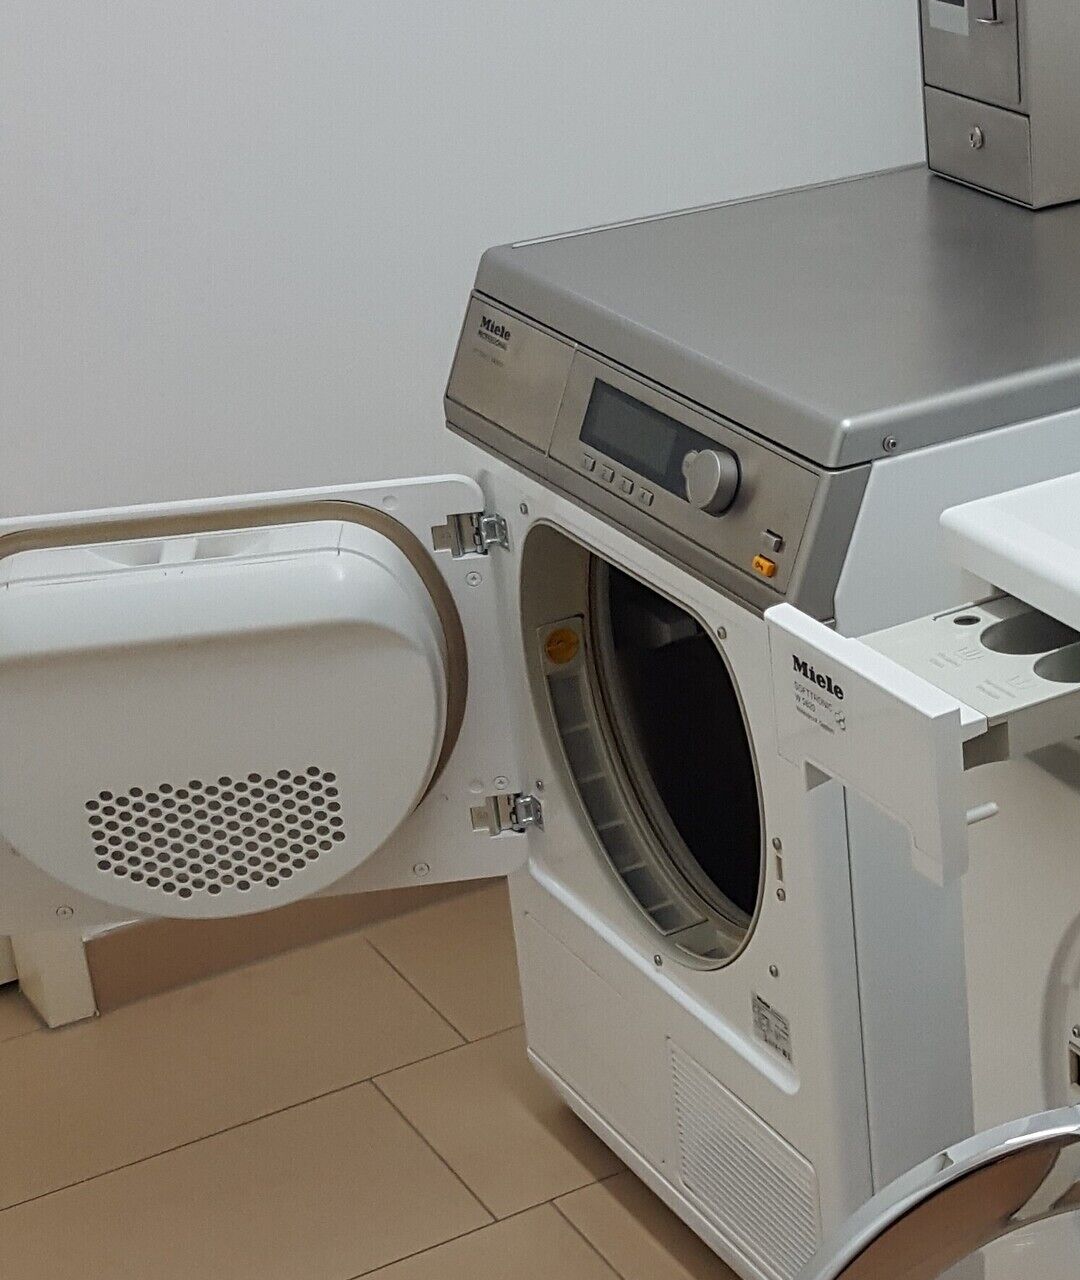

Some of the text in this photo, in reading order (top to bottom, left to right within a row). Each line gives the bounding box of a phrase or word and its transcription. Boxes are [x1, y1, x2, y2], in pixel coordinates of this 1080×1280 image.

[481, 315, 511, 342] Miele
[792, 654, 844, 700] Miele
[794, 680, 833, 713] SOFTTRONIC
